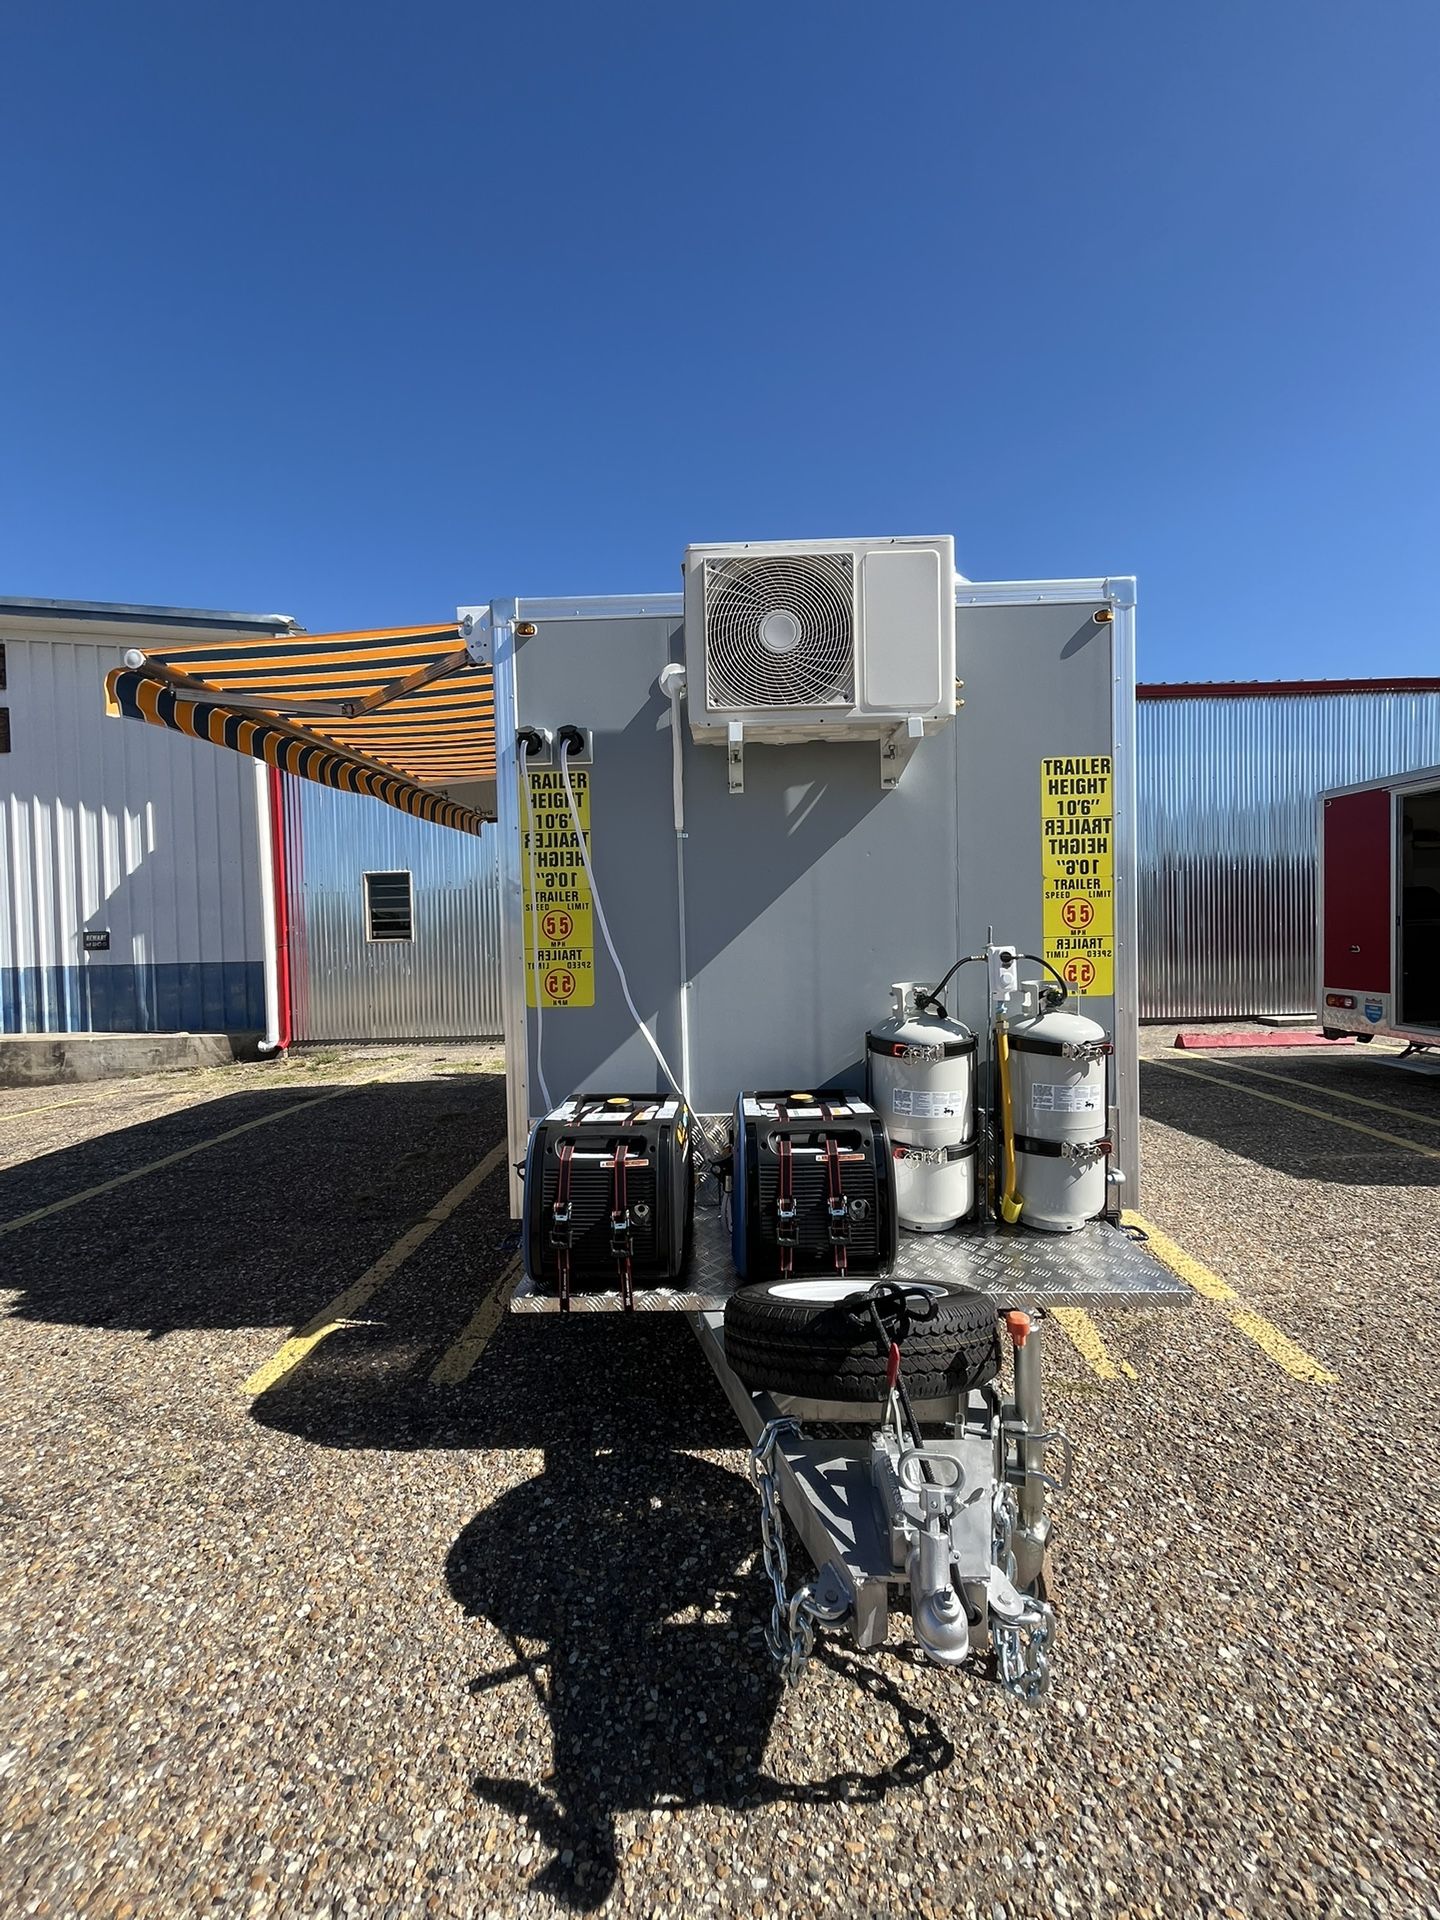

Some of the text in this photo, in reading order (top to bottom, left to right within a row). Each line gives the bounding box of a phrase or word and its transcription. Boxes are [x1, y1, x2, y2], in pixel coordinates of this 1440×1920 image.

[1043, 758, 1111, 776] TRAILER
[522, 772, 588, 790] RAILER
[1048, 778, 1107, 795] HEIGHT
[530, 792, 584, 809] HEIGT
[1056, 799, 1100, 816] 10'6"
[1053, 878, 1101, 890] TRAILER
[1045, 890, 1112, 899] SPEED LIMIT
[567, 902, 589, 910] LIMIT
[1066, 905, 1090, 923] 55
[546, 917, 569, 935] 55
